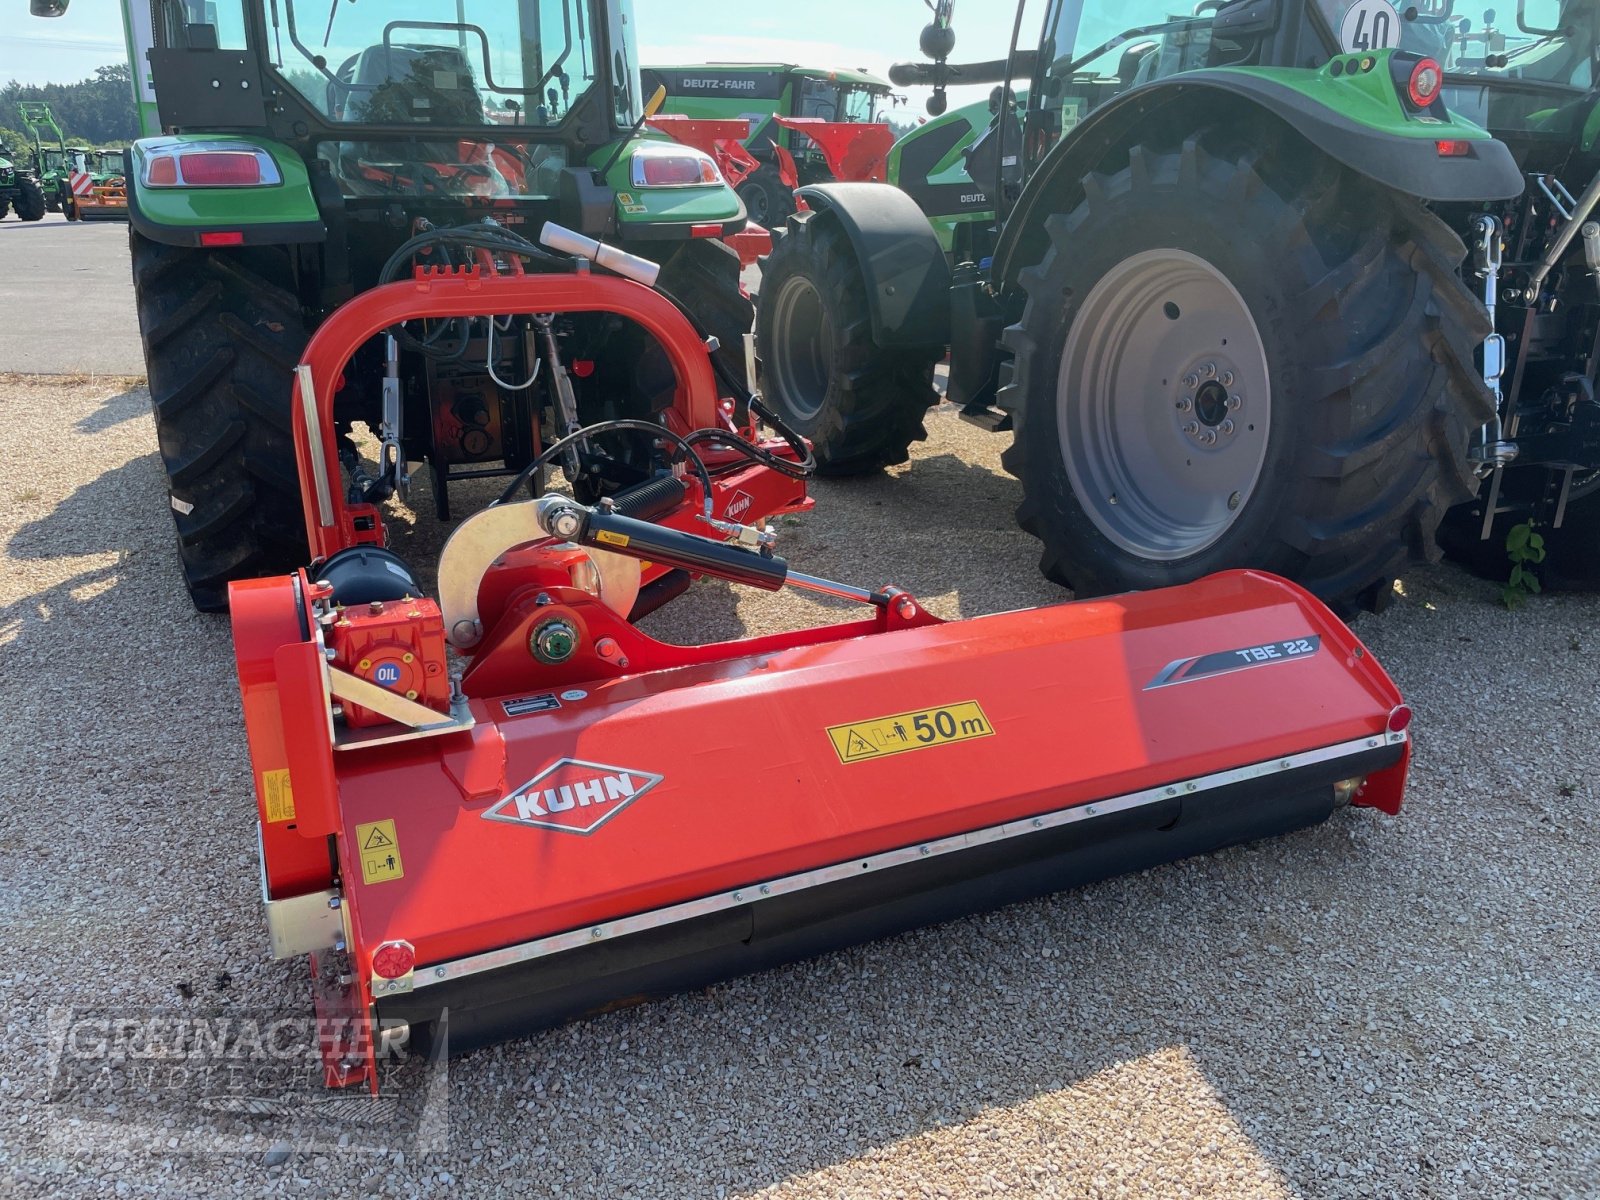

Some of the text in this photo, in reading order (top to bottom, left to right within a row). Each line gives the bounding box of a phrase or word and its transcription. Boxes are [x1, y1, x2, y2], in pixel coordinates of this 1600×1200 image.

[1352, 10, 1390, 52] 40
[683, 79, 755, 89] DEUTZ-FAHR
[960, 193, 986, 202] DEUTZ
[728, 496, 750, 518] KUHN
[1235, 639, 1313, 662] TBE 22
[378, 668, 397, 680] OIL
[912, 711, 985, 743] 50 m
[514, 772, 635, 820] KUHN
